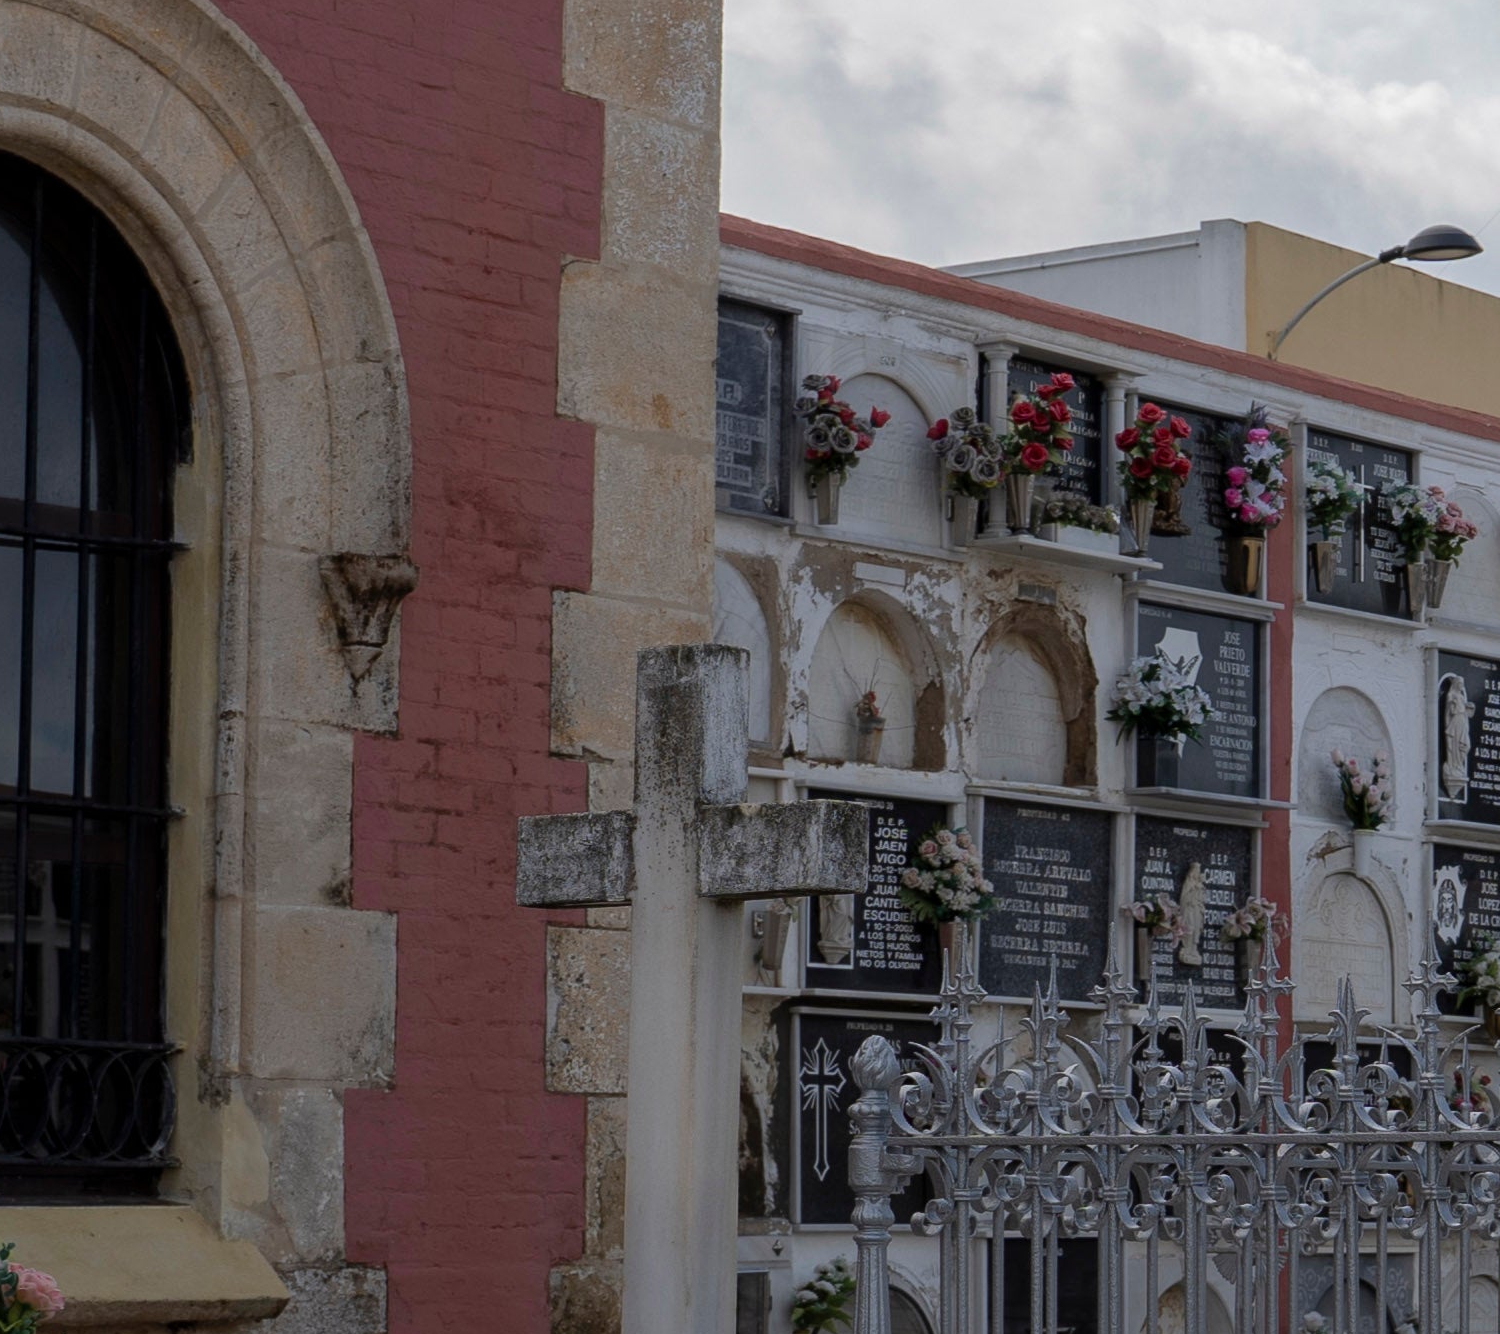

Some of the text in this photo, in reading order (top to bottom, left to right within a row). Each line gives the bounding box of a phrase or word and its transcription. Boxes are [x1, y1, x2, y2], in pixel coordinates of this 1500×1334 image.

[874, 827, 908, 840] JOSE
[875, 840, 908, 852] JAEN
[875, 853, 907, 865] VIGO
